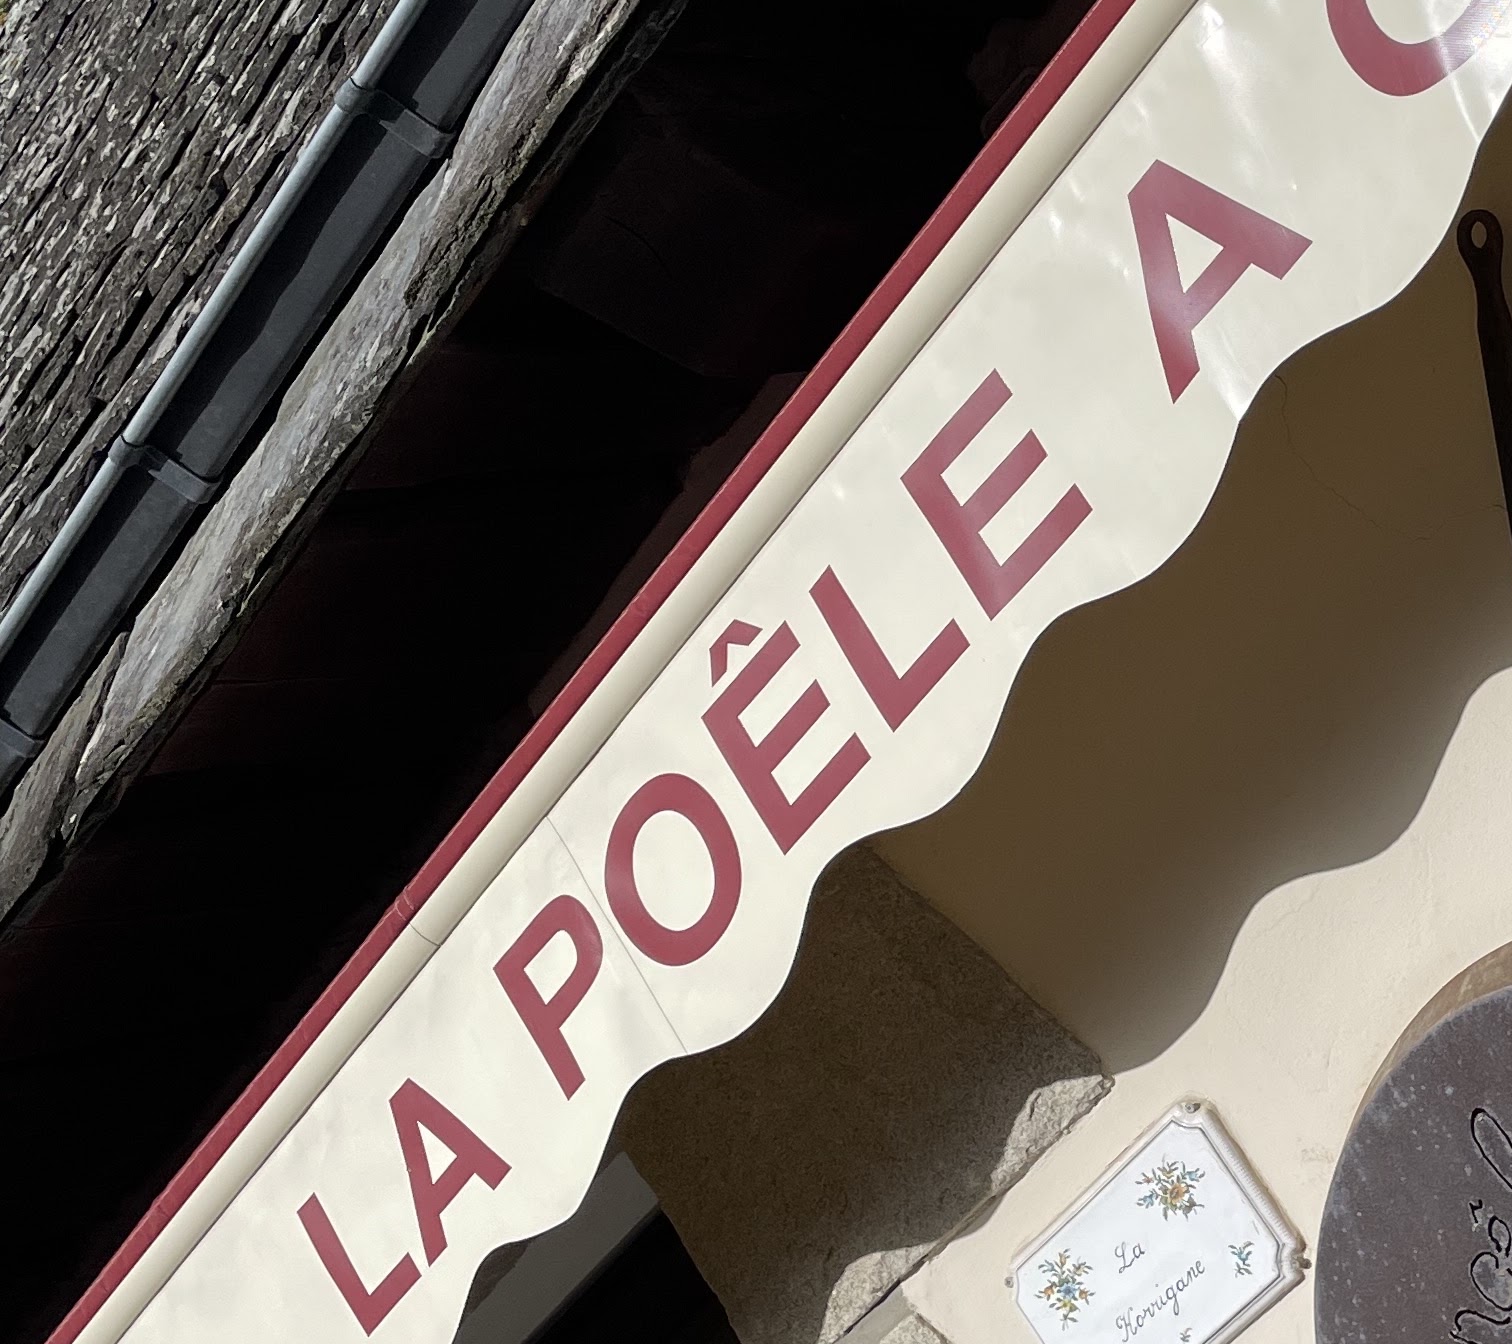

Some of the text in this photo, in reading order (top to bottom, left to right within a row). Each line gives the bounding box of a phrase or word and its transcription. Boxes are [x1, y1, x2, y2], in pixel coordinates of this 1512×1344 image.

[297, 1078, 512, 1336] LA
[493, 370, 1093, 1100] POÊLE
[1127, 160, 1312, 404] A
[1114, 1241, 1146, 1274] La
[1115, 1259, 1206, 1343] Korrigane
